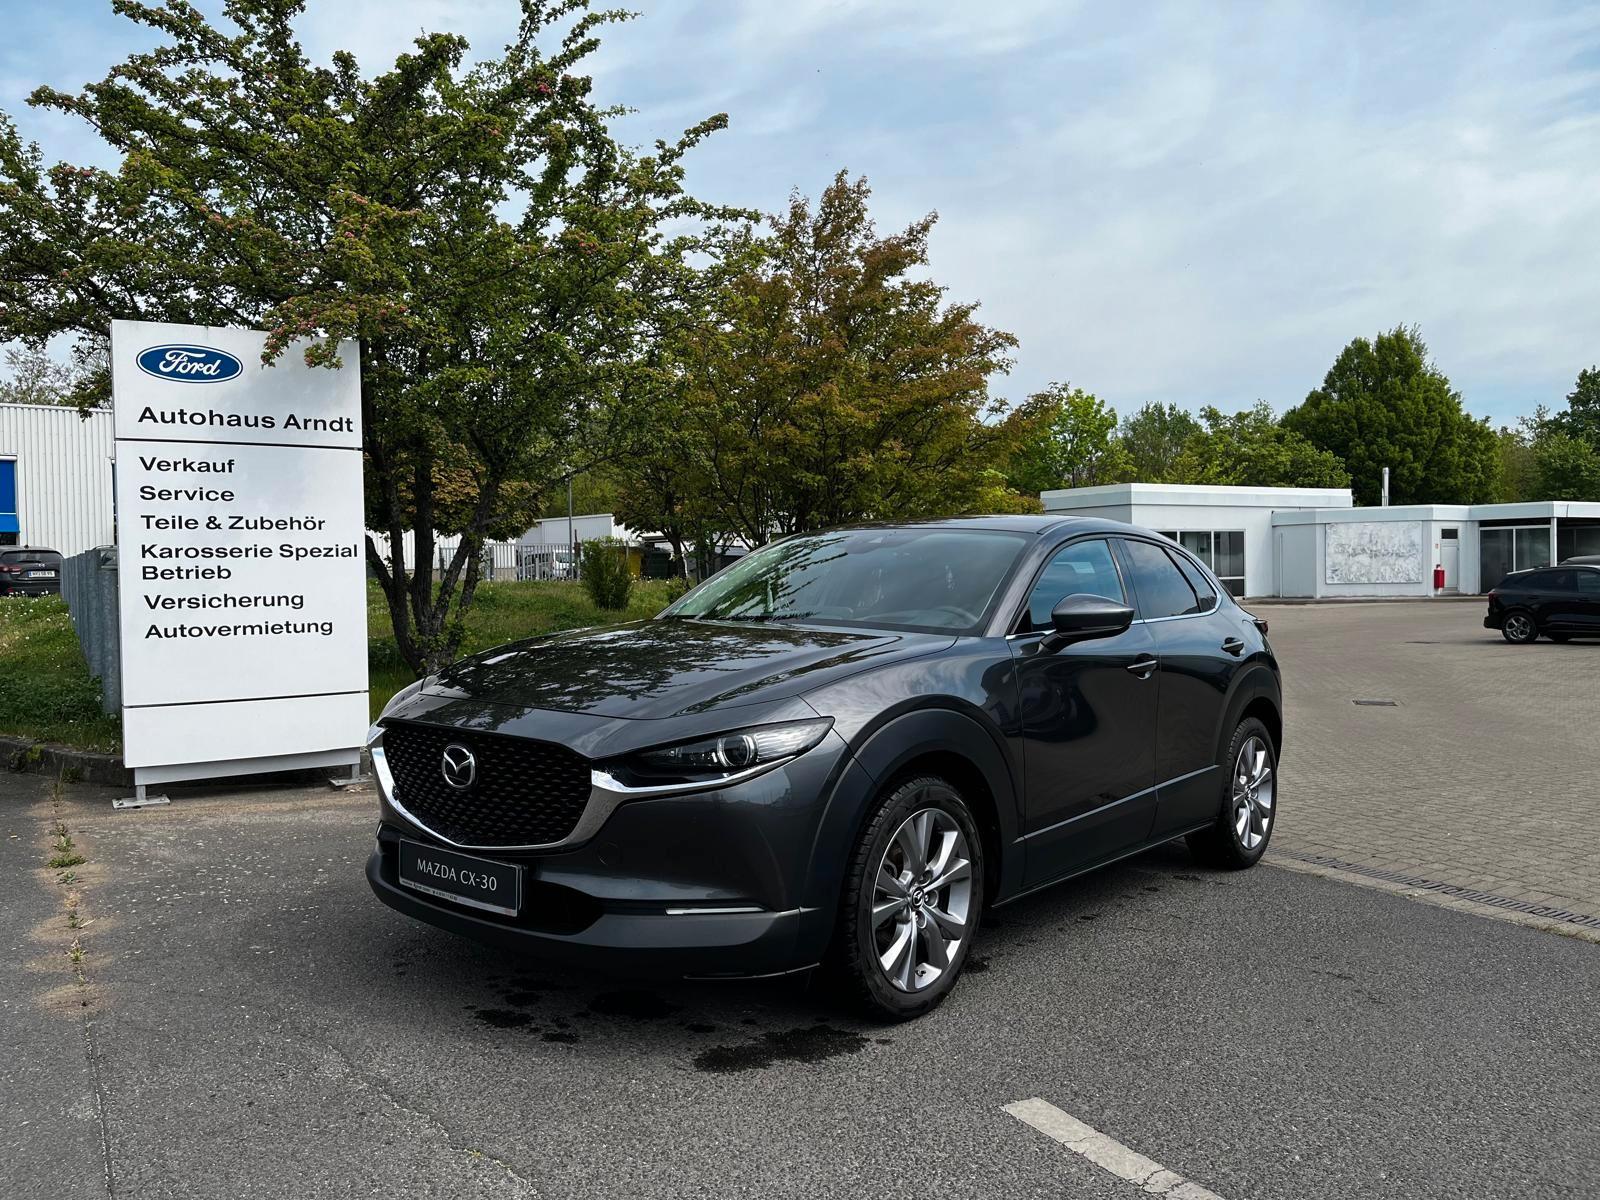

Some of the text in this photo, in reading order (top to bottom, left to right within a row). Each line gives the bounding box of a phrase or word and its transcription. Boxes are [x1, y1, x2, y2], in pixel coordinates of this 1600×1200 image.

[158, 349, 221, 376] Ford
[137, 406, 354, 432] Autohaus Arndt
[138, 456, 235, 474] Verkauf
[139, 485, 235, 502] Service
[140, 514, 326, 531] Teile & Zubehör
[141, 543, 358, 561] Karosserie Spezial
[142, 565, 232, 581] Betrieb
[143, 593, 304, 610] Versicherung
[144, 620, 333, 639] Autovermietung
[416, 858, 457, 882] MAZDA
[460, 870, 498, 891] CX-30
